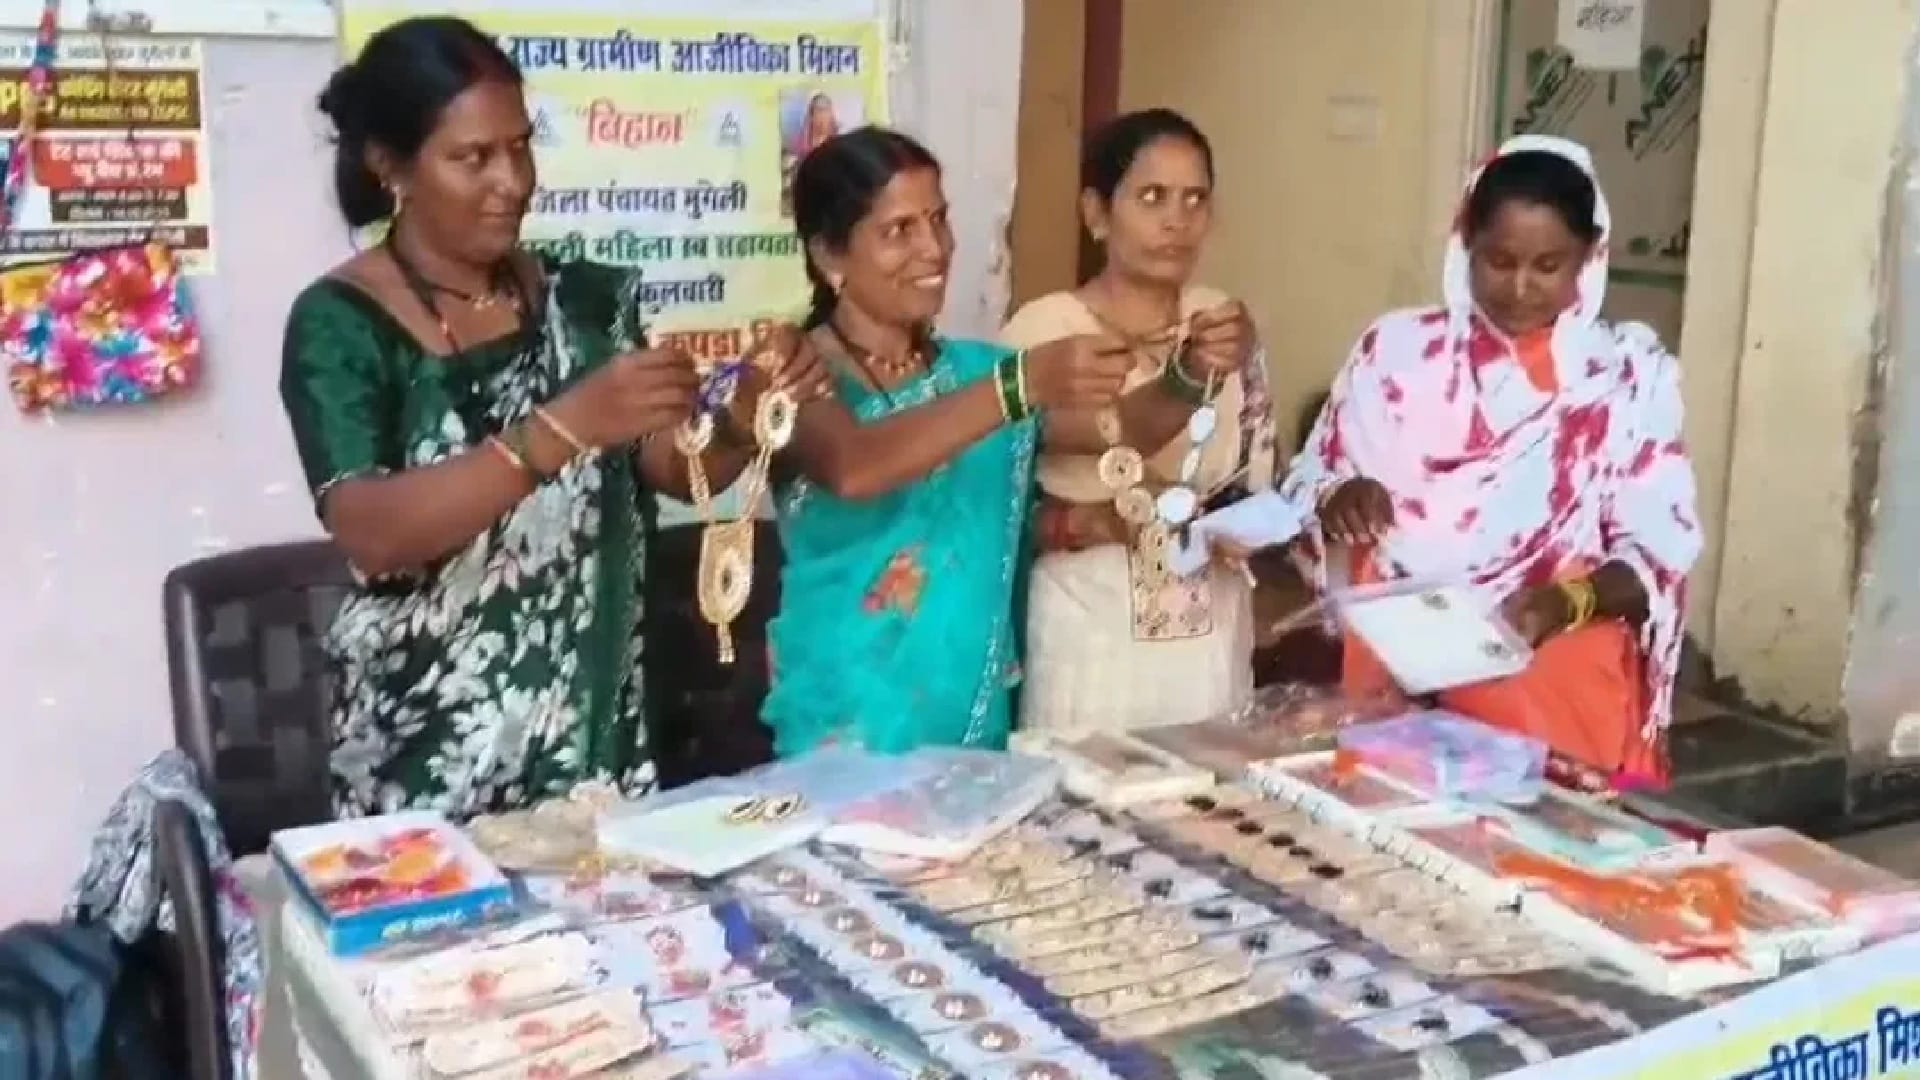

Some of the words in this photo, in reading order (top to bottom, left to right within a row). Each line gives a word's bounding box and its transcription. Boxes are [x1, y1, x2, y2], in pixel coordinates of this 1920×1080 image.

[575, 29, 661, 72] ग्रामीण
[671, 31, 790, 73] आजीविका
[797, 33, 862, 76] मिशन
[597, 178, 676, 213] पंचायत
[593, 229, 672, 260] महिला
